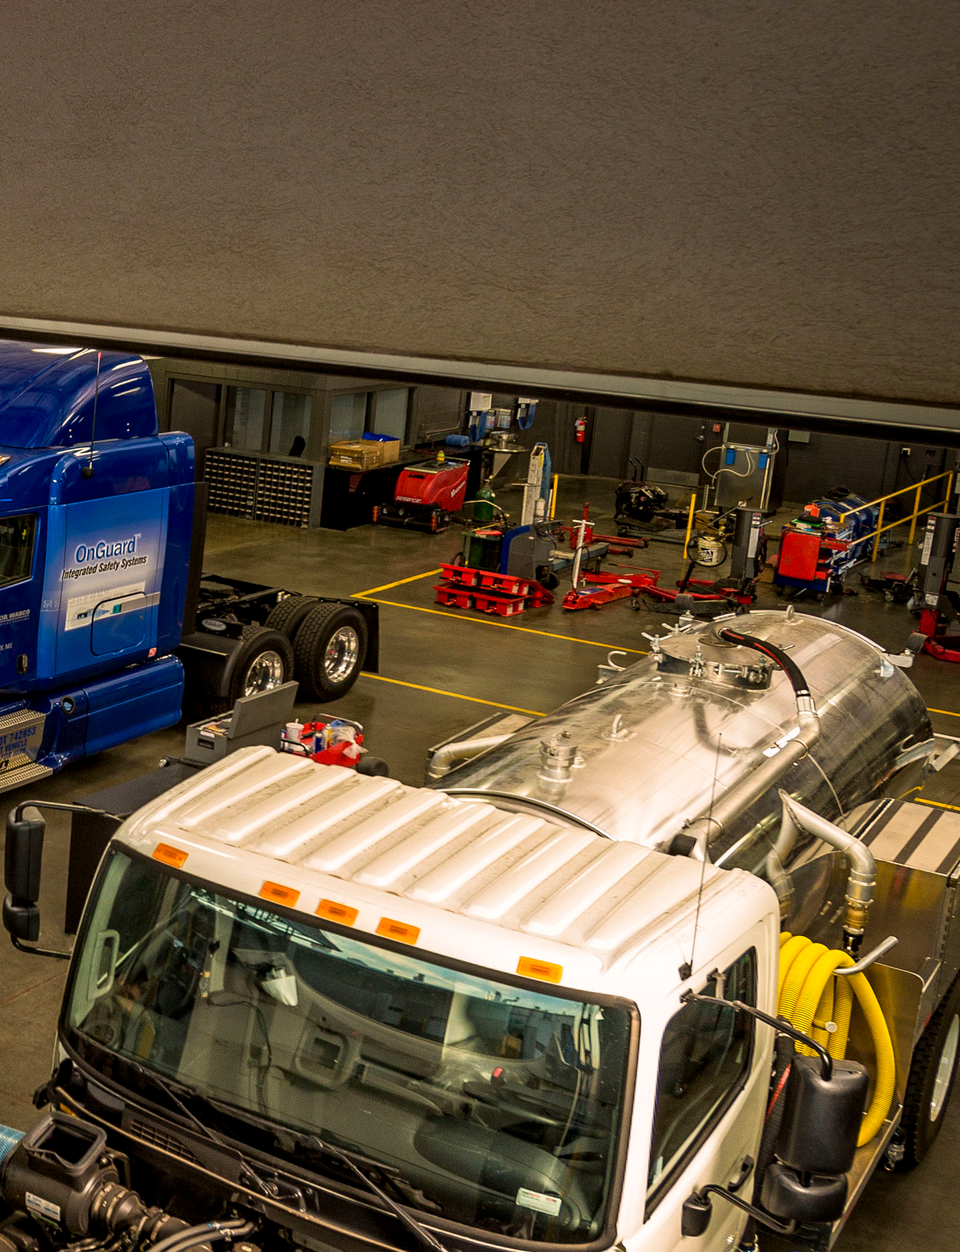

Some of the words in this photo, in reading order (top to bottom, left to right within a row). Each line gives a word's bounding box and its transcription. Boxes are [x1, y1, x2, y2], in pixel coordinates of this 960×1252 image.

[75, 536, 137, 563] OnGuard
[62, 563, 97, 579] Integrated
[98, 560, 120, 573] Safety
[121, 556, 147, 569] Systems
[9, 609, 31, 619] WABCO
[5, 738, 28, 752] VEHICLE
